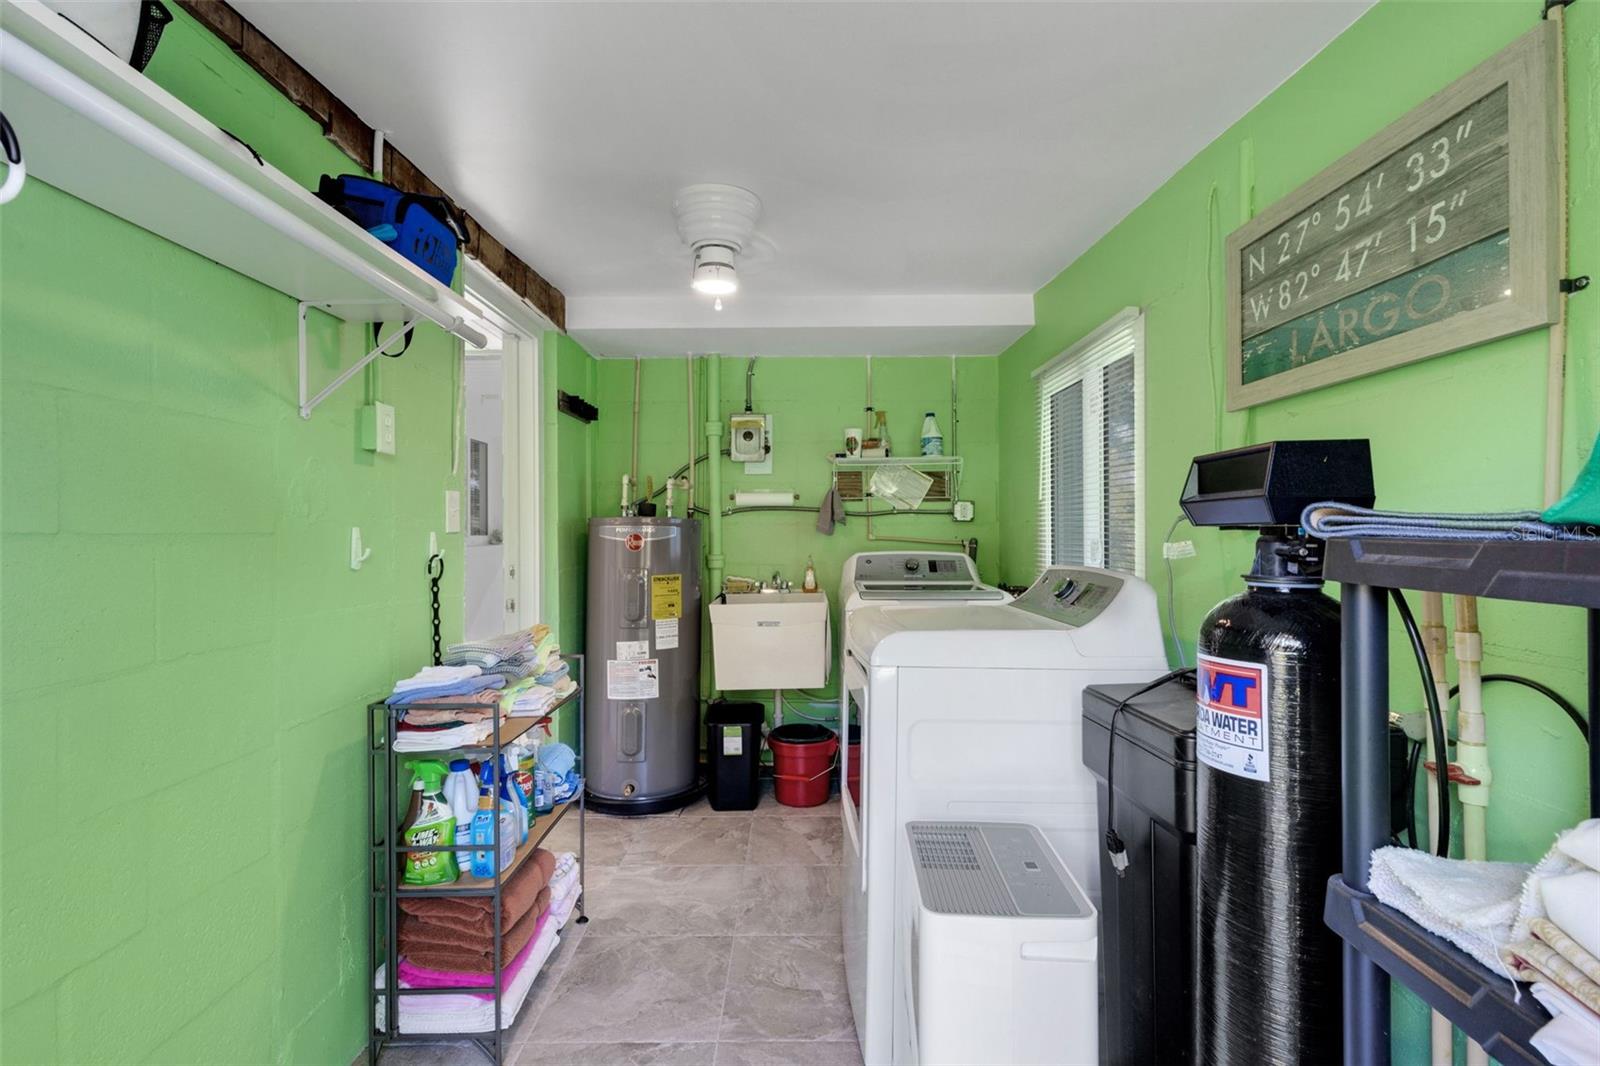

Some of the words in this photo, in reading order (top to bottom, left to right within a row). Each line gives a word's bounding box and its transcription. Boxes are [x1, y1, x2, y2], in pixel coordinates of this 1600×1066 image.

[1249, 247, 1265, 280] N
[1289, 274, 1450, 368] LARGO
[1212, 711, 1257, 737] WATER
